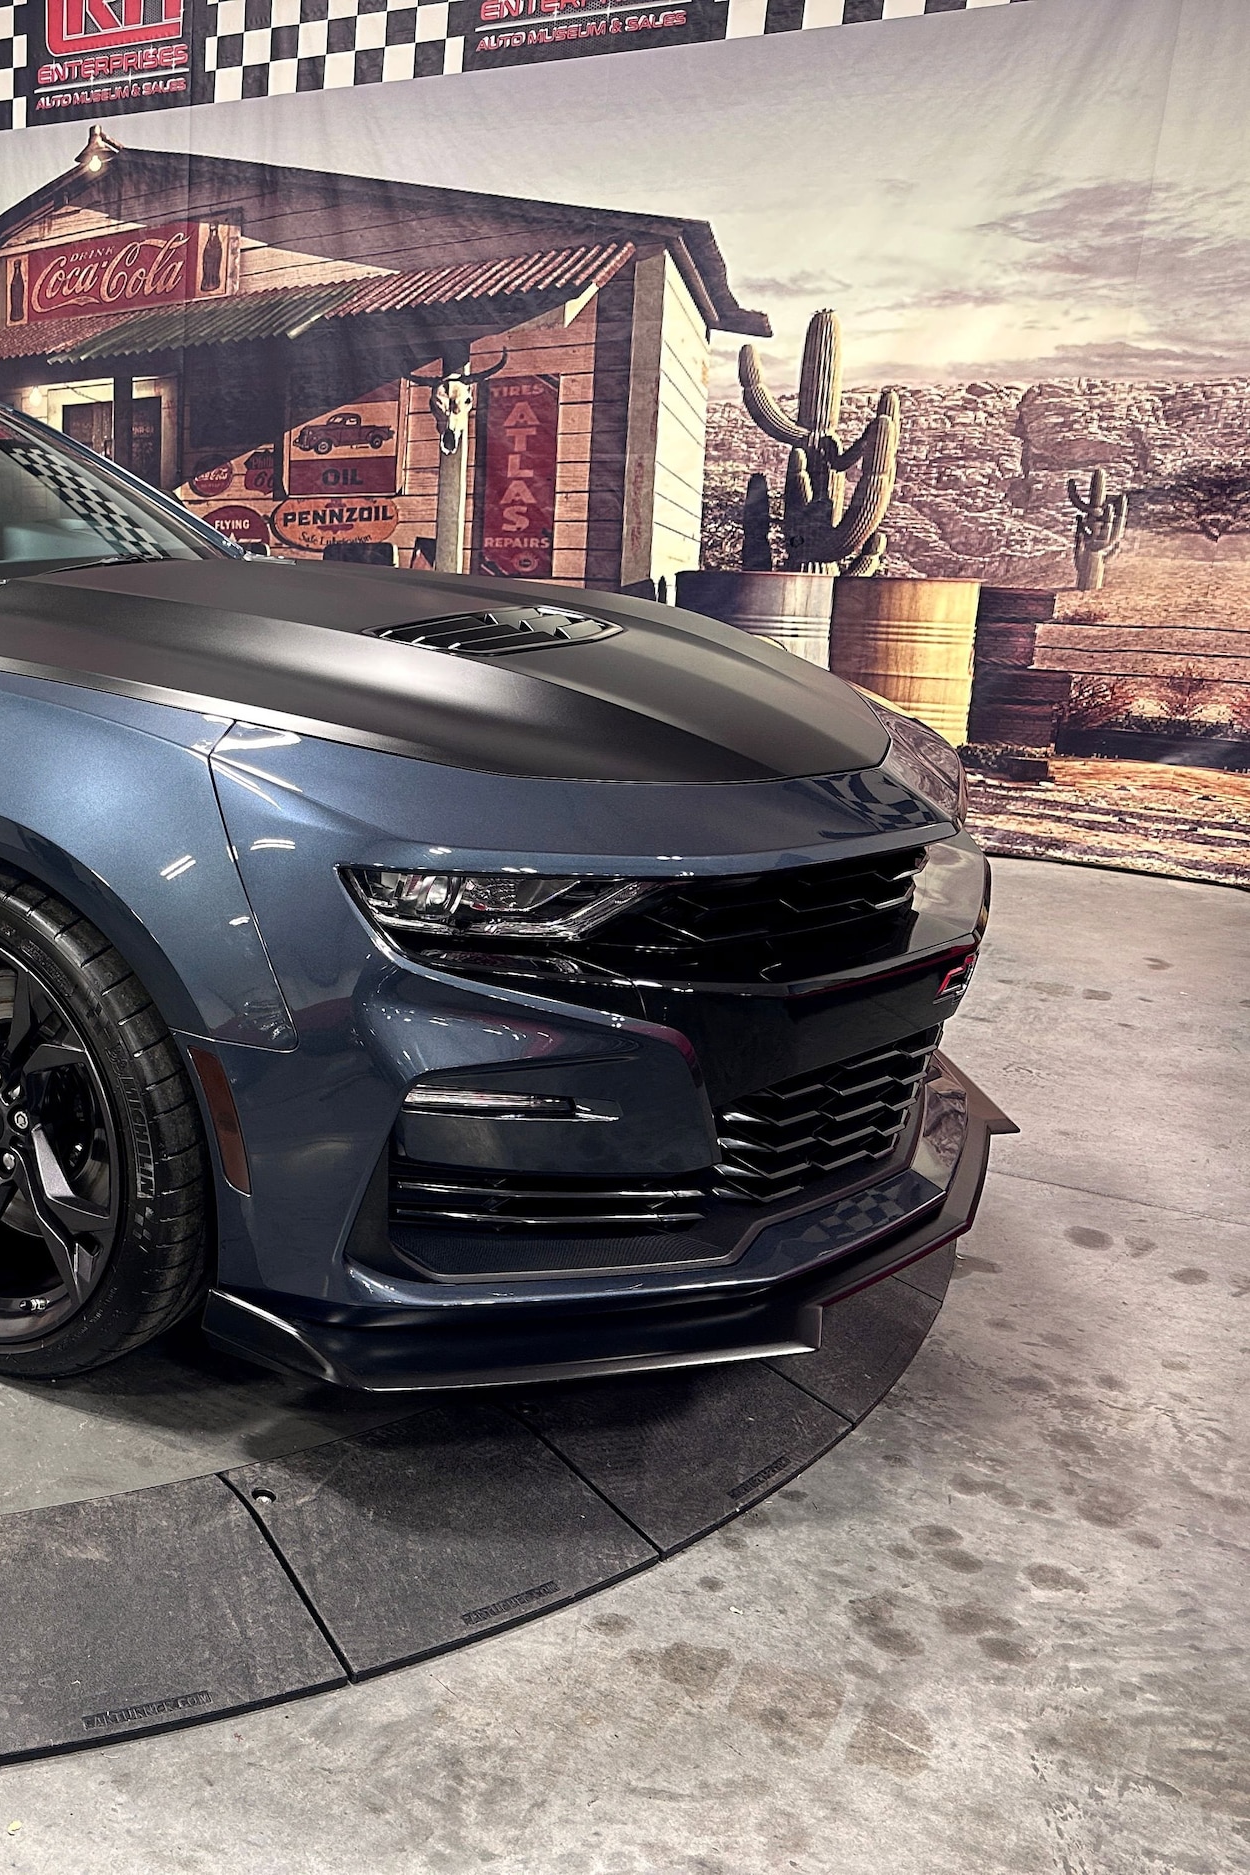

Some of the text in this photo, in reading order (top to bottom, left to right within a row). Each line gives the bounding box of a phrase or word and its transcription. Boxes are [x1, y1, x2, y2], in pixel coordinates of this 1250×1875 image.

[476, 10, 687, 52] AUTO MUSEUM & SALES
[37, 43, 189, 85] ENTERPRISES
[35, 78, 187, 110] AUTO MUSEUM & SALES
[69, 245, 115, 263] DRINK
[31, 232, 191, 313] Coca-Cola
[490, 383, 545, 398] TIRES
[322, 468, 364, 486] OIL
[500, 401, 542, 532] ATLAS
[214, 519, 250, 530] FLYING
[282, 505, 394, 527] PENNZOIL
[484, 537, 550, 549] REPAIRS
